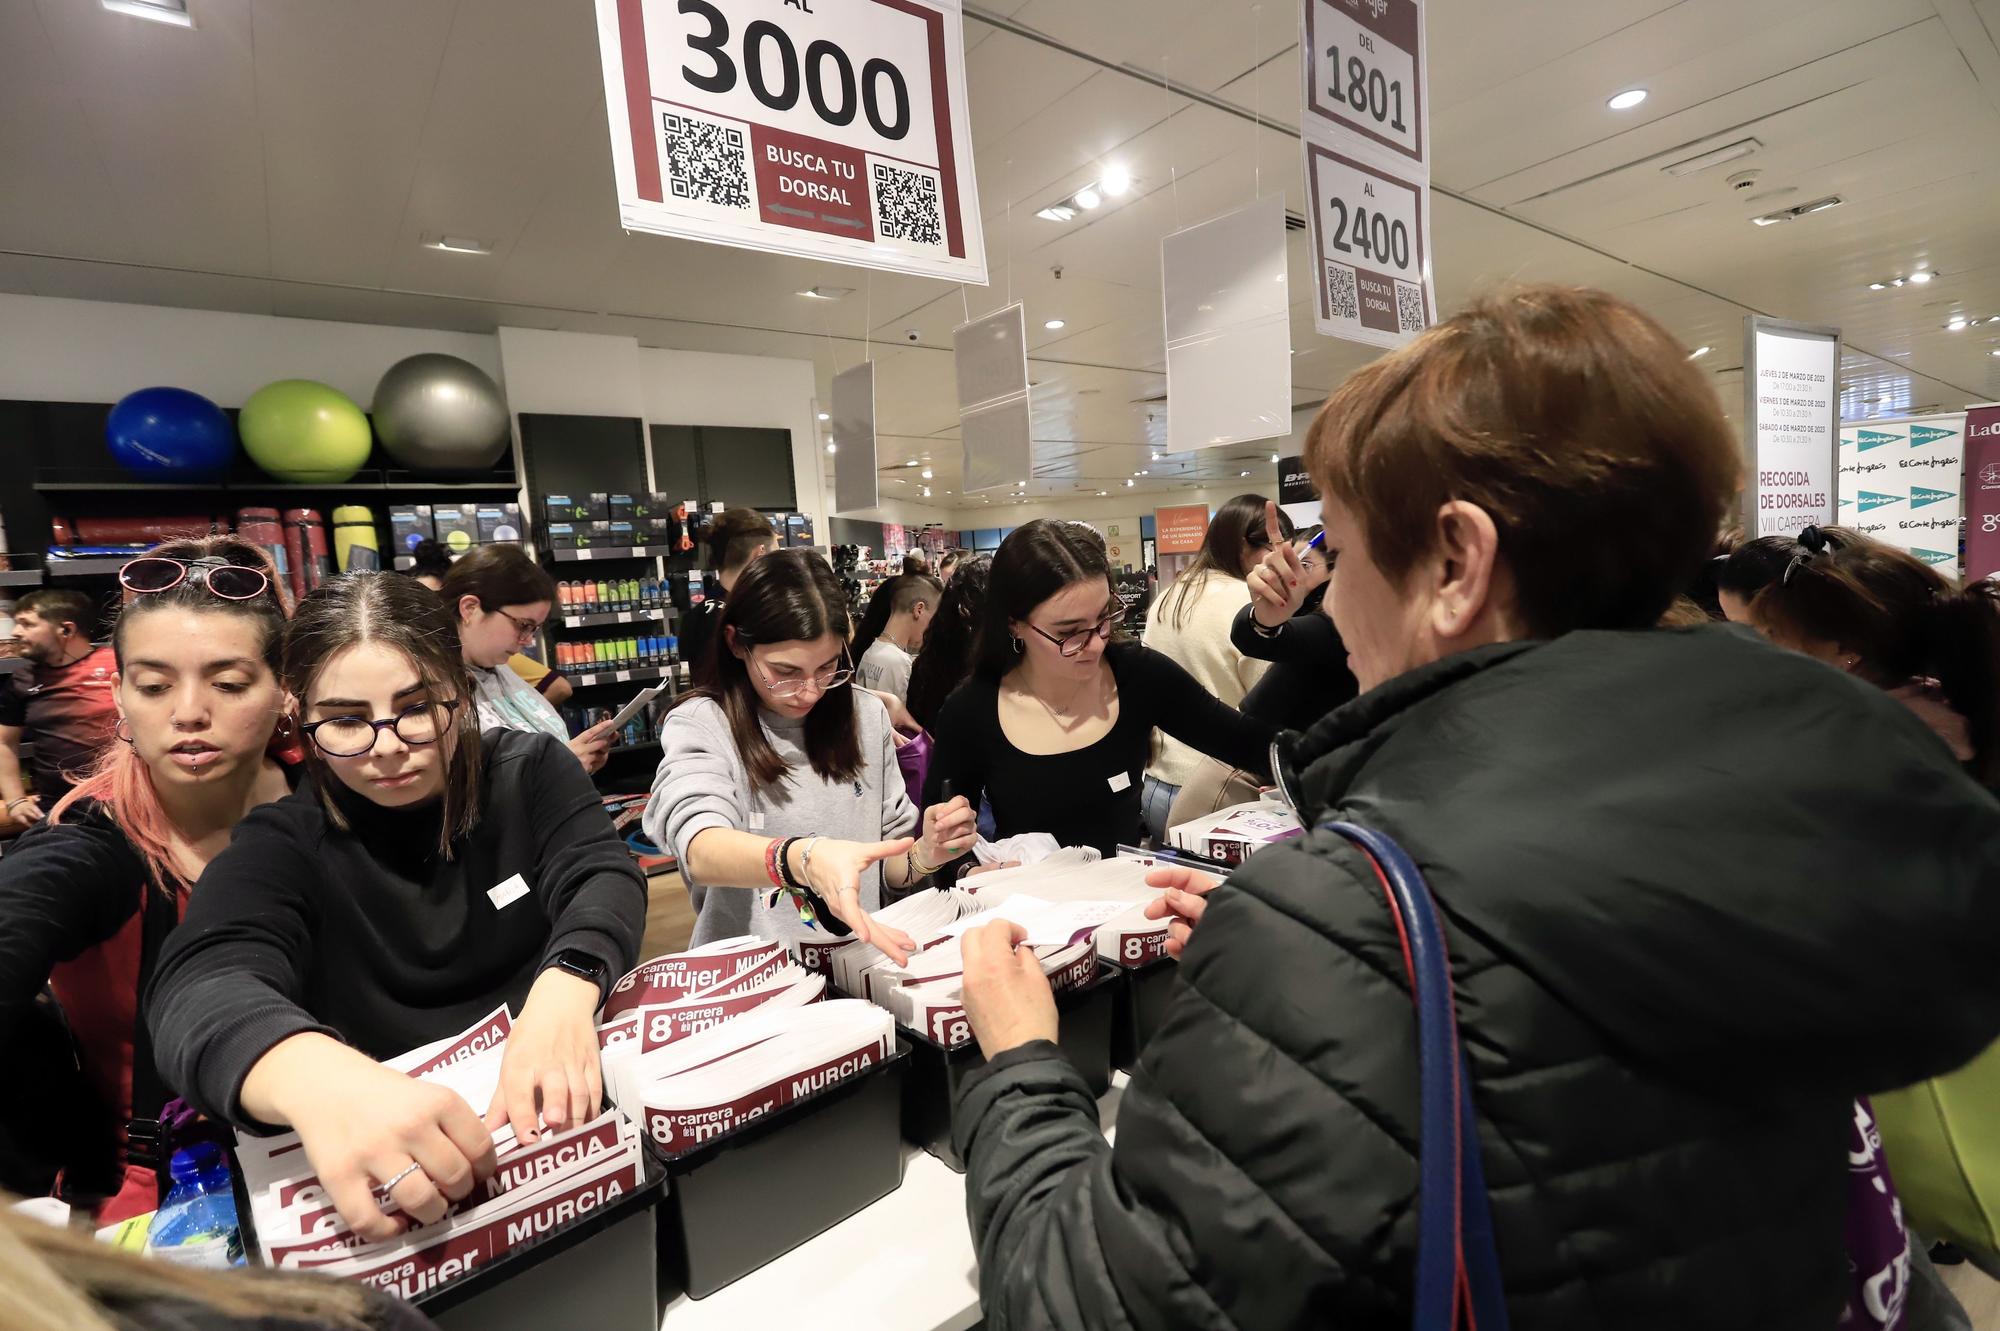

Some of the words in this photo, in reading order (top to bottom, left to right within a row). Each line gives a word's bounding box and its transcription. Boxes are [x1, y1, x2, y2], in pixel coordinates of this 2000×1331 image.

[1359, 33, 1375, 54] DEL
[678, 0, 911, 141] 3000
[1326, 45, 1407, 134] 1801
[766, 145, 829, 175] BUSCA
[831, 159, 856, 180] TU
[779, 175, 852, 207] DORSAL
[1363, 182, 1376, 199] AL
[1330, 197, 1410, 270] 2400
[1360, 280, 1382, 295] BUSCA
[1382, 285, 1392, 296] TU
[1365, 297, 1391, 313] DORSAL
[1782, 371, 1789, 380] DE
[1790, 372, 1807, 381] MARZO
[1807, 374, 1814, 382] DE
[1783, 398, 1790, 406] DE
[1790, 399, 1807, 407] MARZO
[1808, 400, 1814, 408] DE
[1783, 424, 1790, 432] DE
[1790, 425, 1807, 433] MARZO
[1808, 425, 1814, 433] DE
[1899, 459, 1908, 469] El
[1908, 458, 1929, 468] Corte
[1930, 456, 1959, 469] Inglés
[1760, 471, 1810, 487] RECOGIDA
[1761, 494, 1774, 509] DE
[1776, 492, 1826, 509] DORSALES
[1761, 516, 1776, 532] VIII
[1777, 514, 1820, 532] CARRERA
[1899, 520, 1908, 529] El
[1908, 519, 1930, 529] Corte
[1930, 517, 1957, 530] Inglés
[643, 961, 687, 974] carrera
[653, 968, 722, 999] mujer
[677, 1006, 724, 1022] carrera
[792, 1053, 872, 1099] MURCIA
[677, 1107, 734, 1126] carrera
[486, 1135, 607, 1198] MURCIA
[507, 1179, 624, 1246] MURCIA
